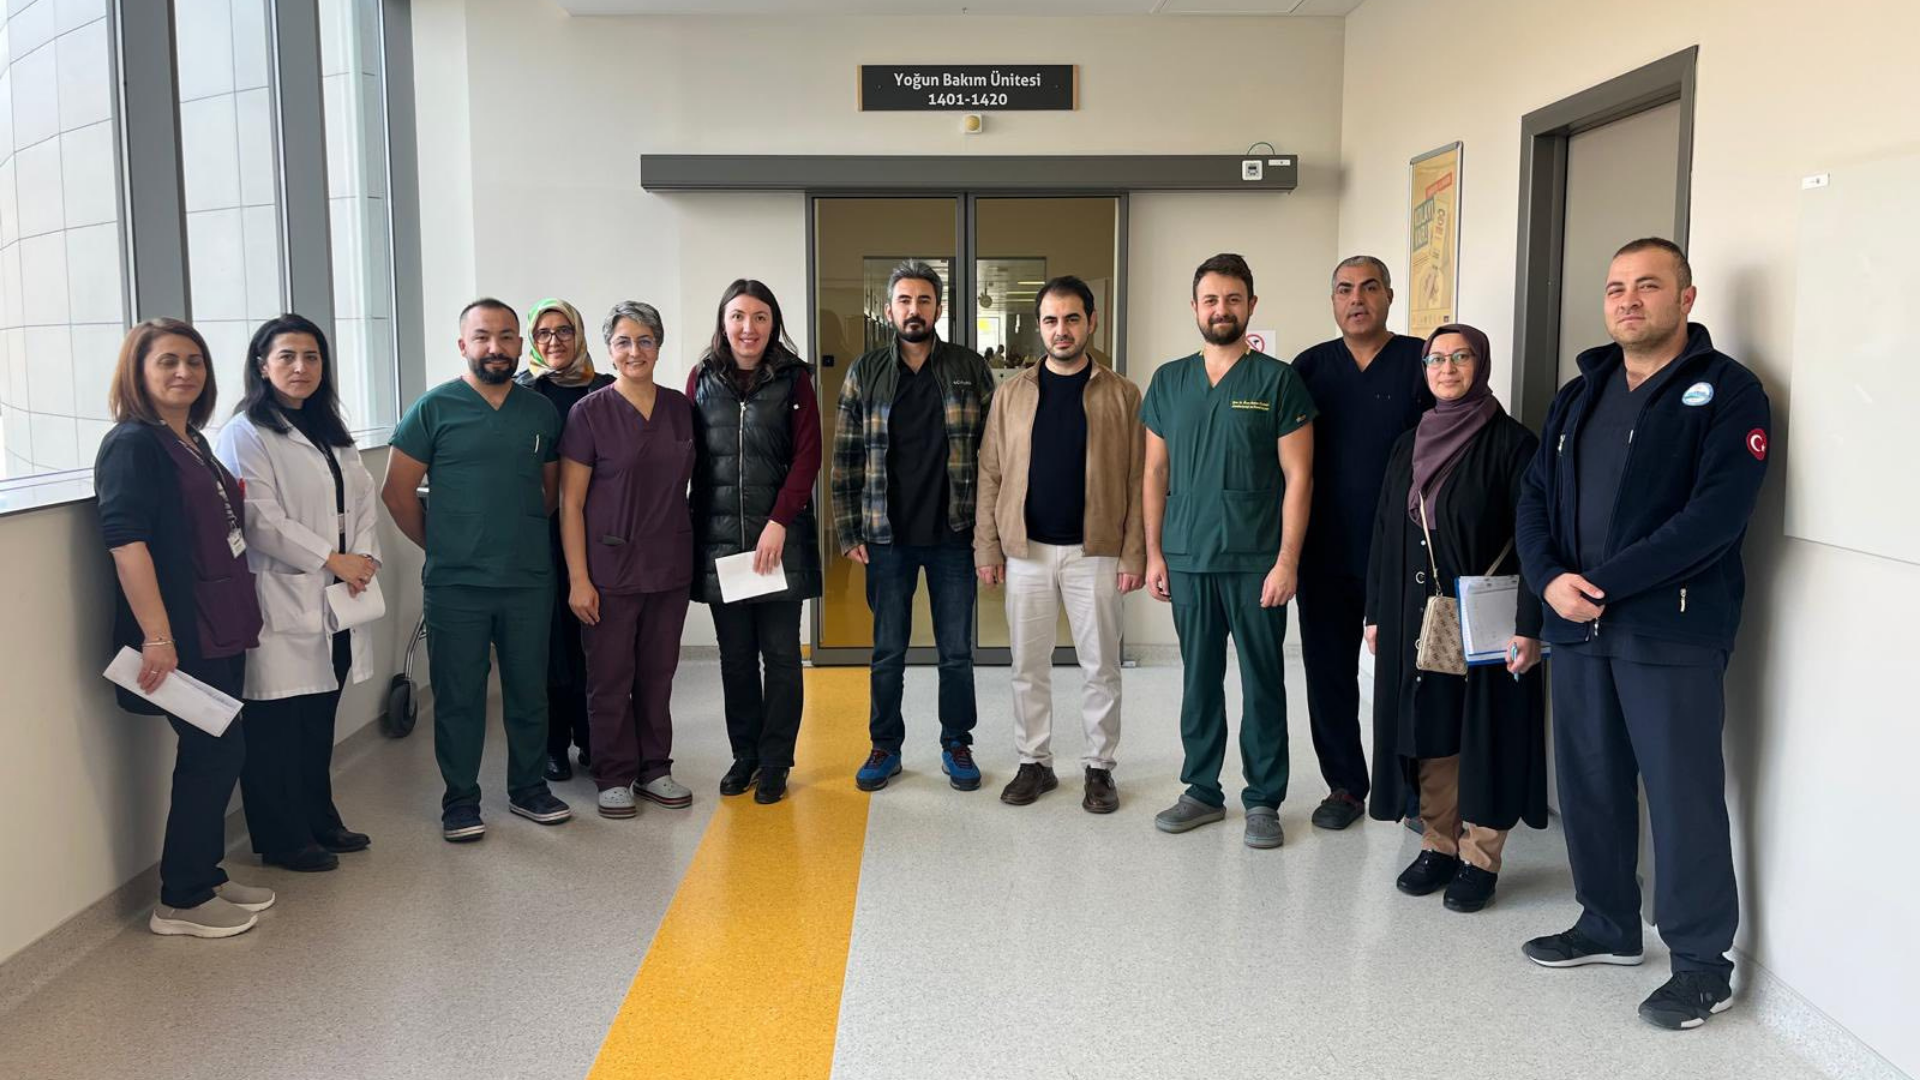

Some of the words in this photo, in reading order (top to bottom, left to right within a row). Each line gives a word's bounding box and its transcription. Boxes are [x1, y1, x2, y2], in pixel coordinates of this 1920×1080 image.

[893, 72, 940, 90] Yoğun
[943, 72, 987, 87] Bakım
[990, 70, 1041, 87] Ünitesi
[928, 93, 1008, 106] 1401-1420
